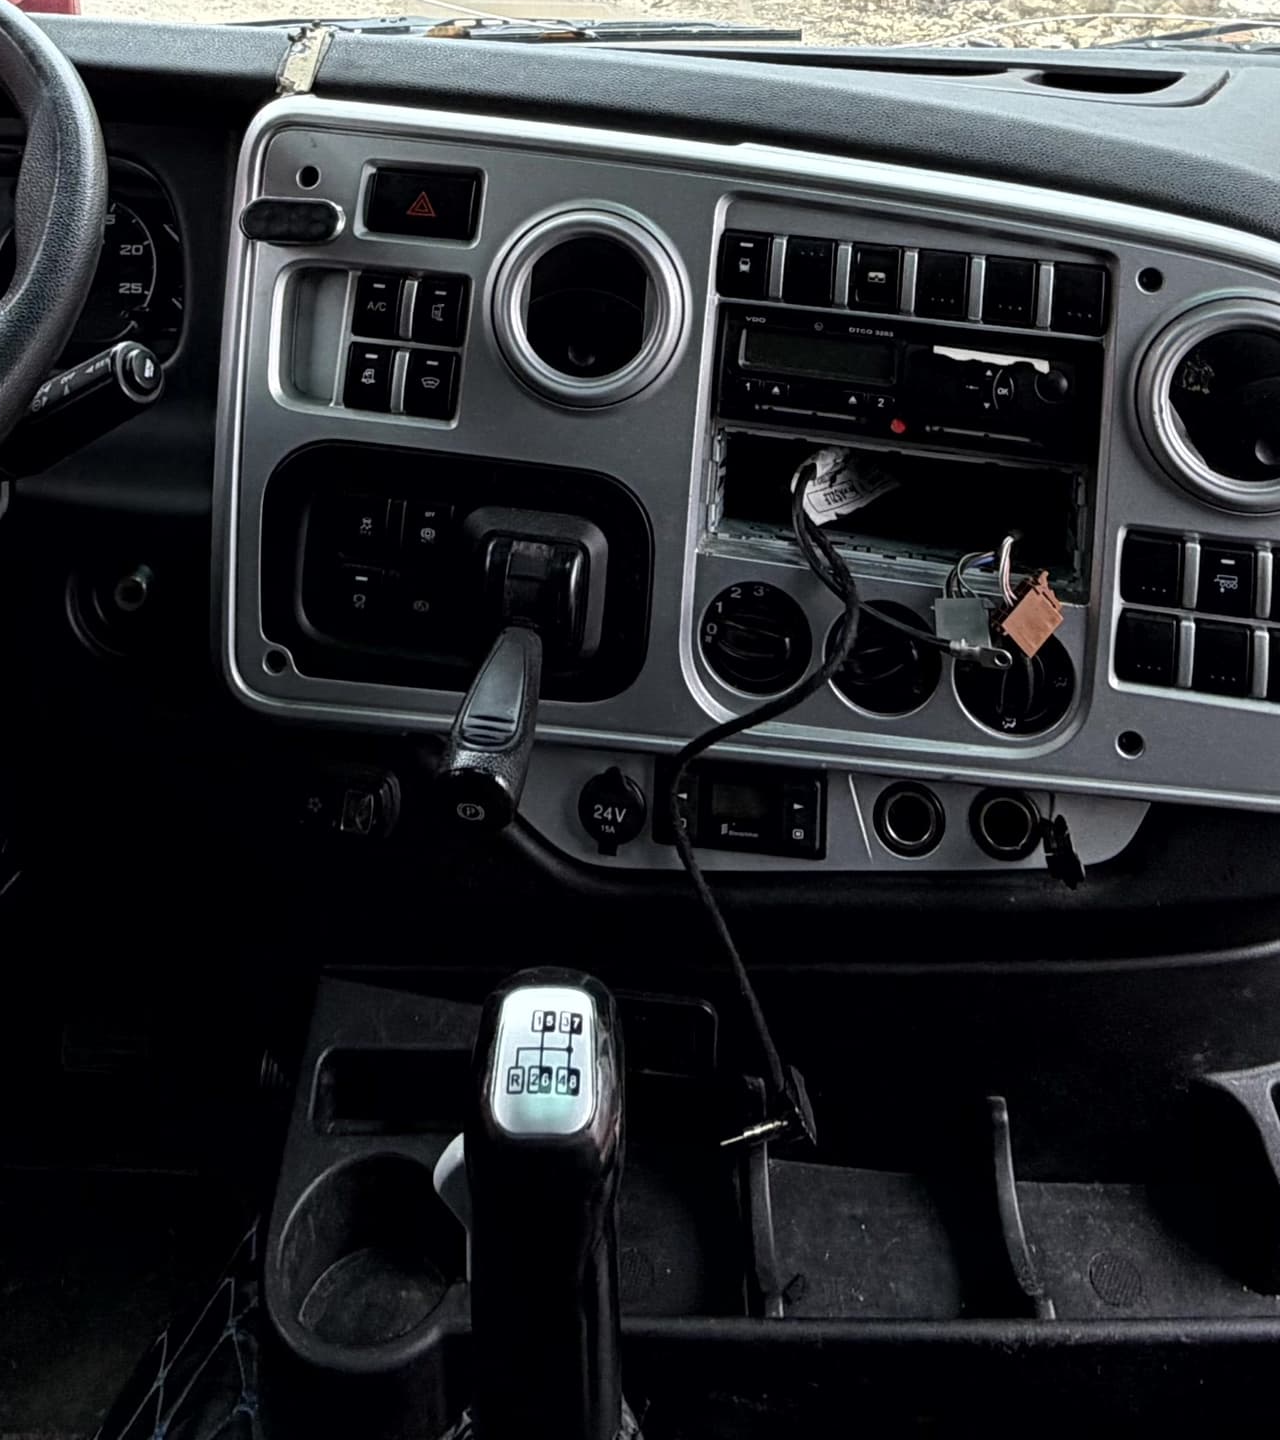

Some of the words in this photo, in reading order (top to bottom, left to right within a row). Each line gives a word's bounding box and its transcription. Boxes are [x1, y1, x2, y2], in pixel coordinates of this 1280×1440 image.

[120, 245, 143, 255] 20
[118, 283, 142, 294] 25
[367, 301, 387, 312] A/C
[745, 316, 766, 324] VDO
[997, 387, 1009, 396] OK
[878, 398, 885, 408] 2
[730, 587, 742, 599] 2
[715, 601, 723, 613] 1
[593, 804, 627, 823] 24V
